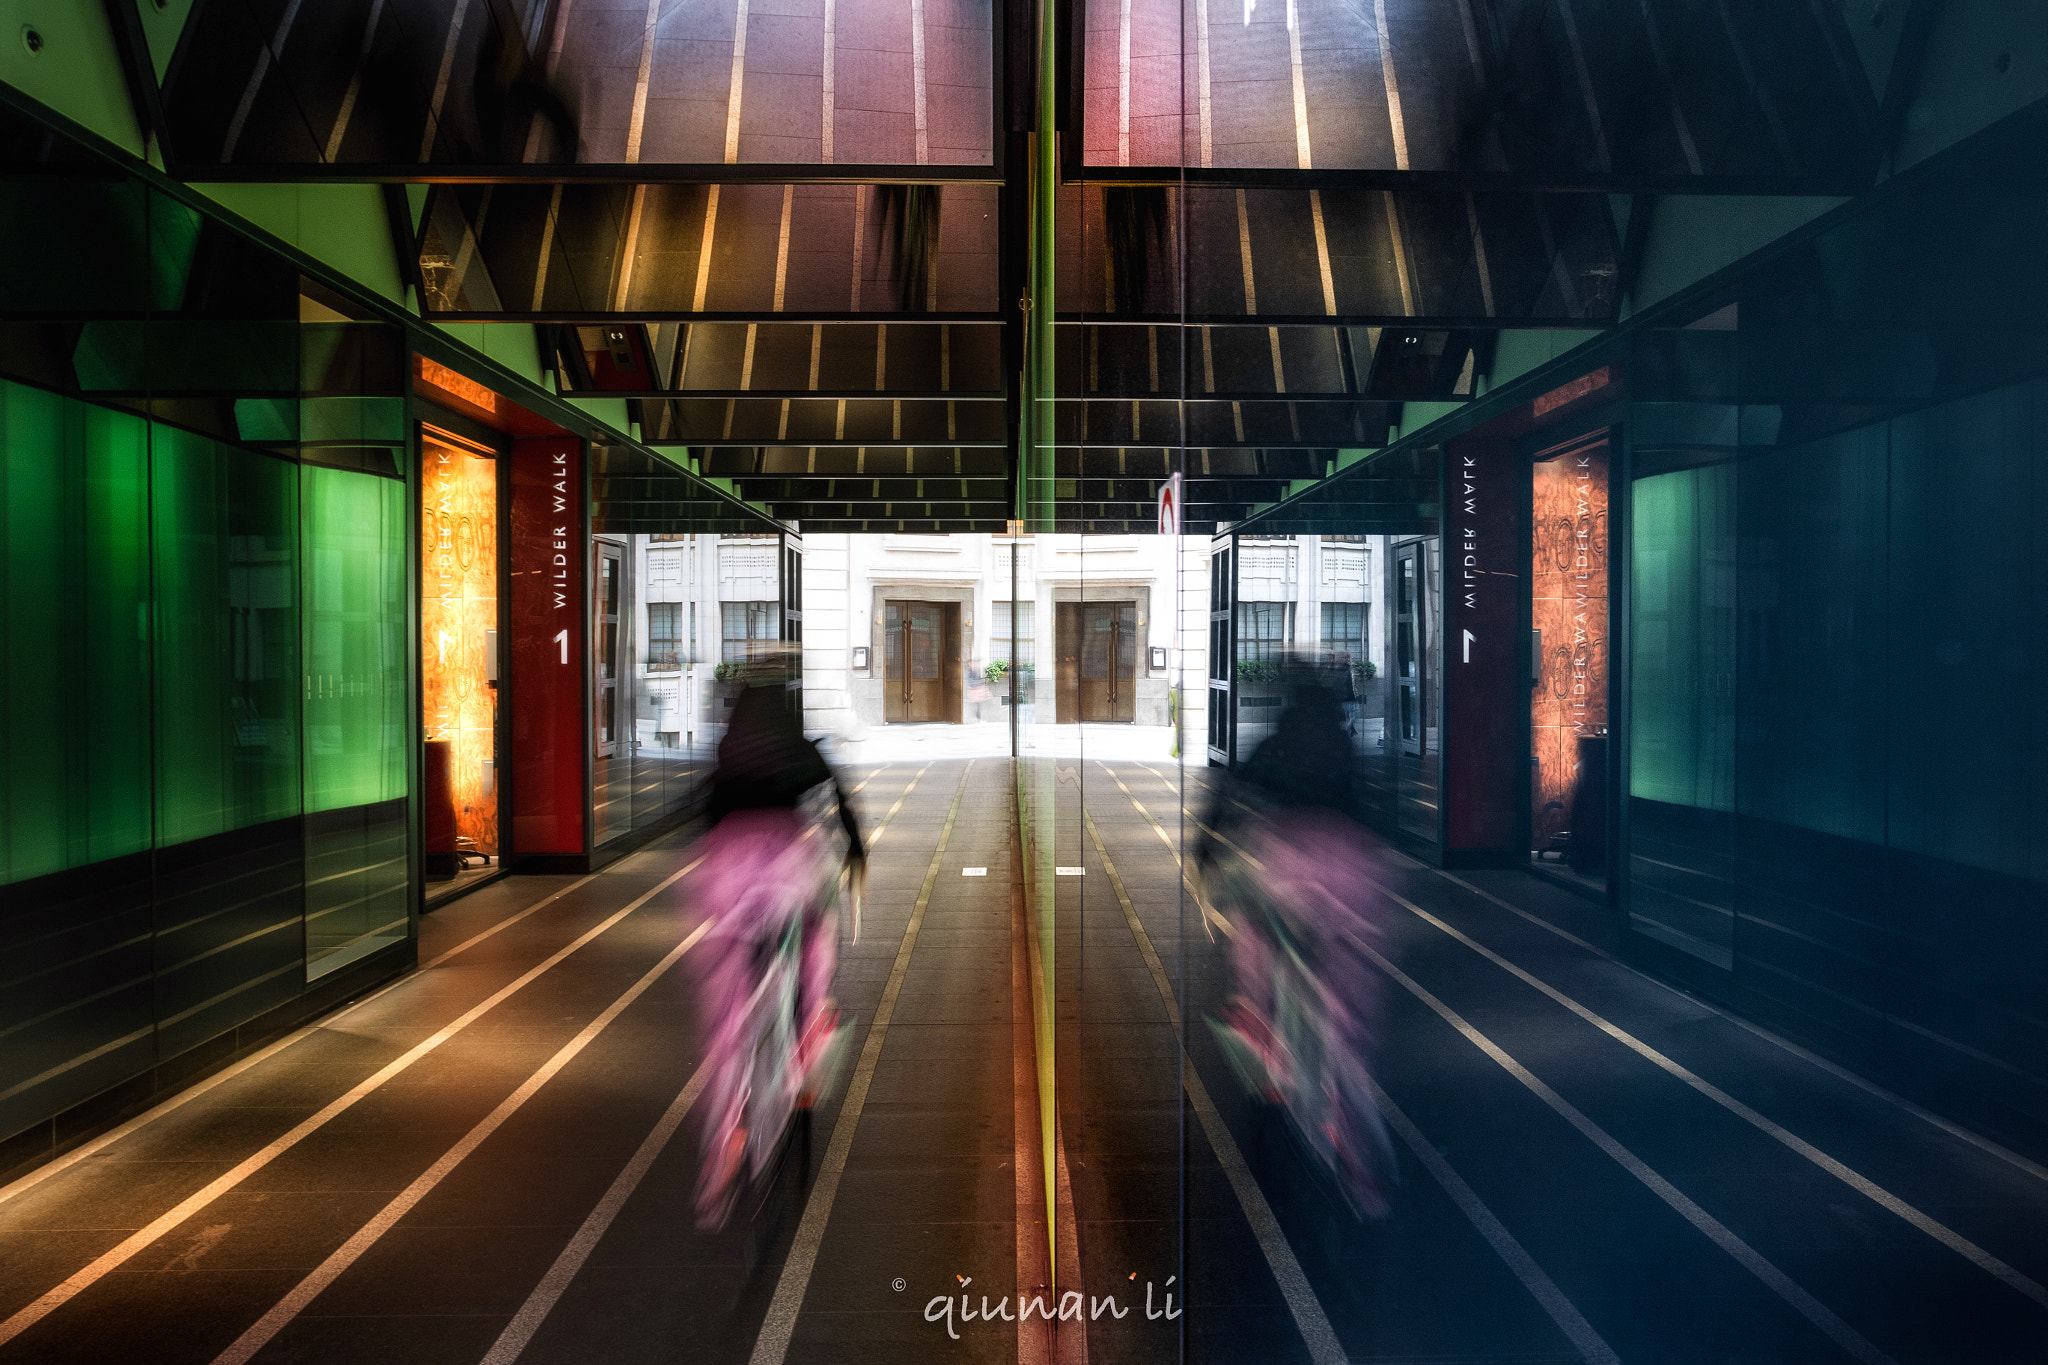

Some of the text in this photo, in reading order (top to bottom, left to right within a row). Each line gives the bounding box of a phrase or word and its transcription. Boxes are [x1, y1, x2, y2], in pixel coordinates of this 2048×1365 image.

[553, 454, 566, 608] WILDER WALK
[1576, 457, 1589, 609] WILDER WALK
[553, 629, 568, 664] 1
[1573, 657, 1586, 737] WILDER
